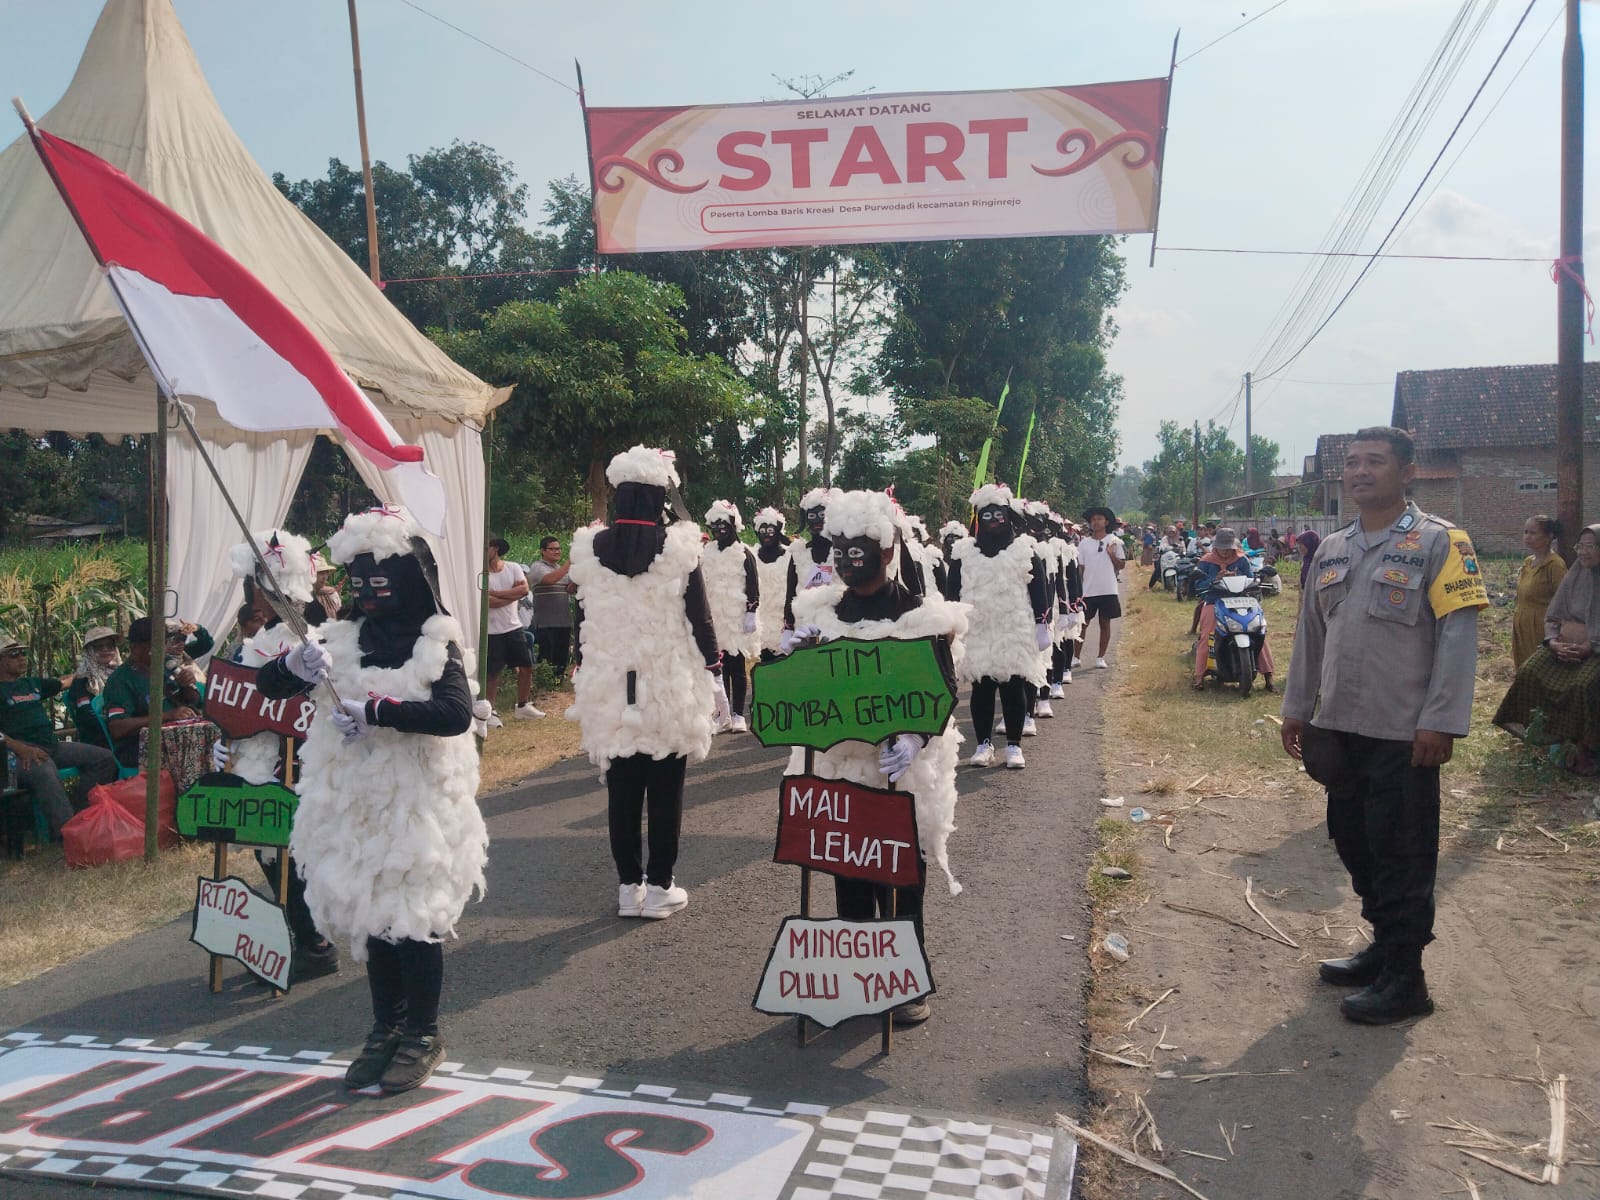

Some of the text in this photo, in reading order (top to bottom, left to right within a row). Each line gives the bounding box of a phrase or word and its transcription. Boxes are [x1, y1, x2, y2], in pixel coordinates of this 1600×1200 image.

[797, 102, 932, 120] SELAMAT DATANG
[716, 117, 1028, 192] START
[710, 196, 1022, 219] Peserta Lomba Baris Kreasi Desa Purwodadi kecamatan Ringinrejo
[1319, 553, 1425, 570] ENDRO POLRI
[818, 645, 882, 678] TIM
[208, 674, 257, 710] HUT
[756, 688, 946, 734] DOMBA GEMOY
[789, 786, 849, 824] MAU
[809, 827, 911, 874] LEWAT
[201, 882, 250, 920] RT.02
[235, 933, 288, 981] RW.01
[788, 926, 899, 960] MINGGIR
[779, 968, 920, 1004] DULU YAAA
